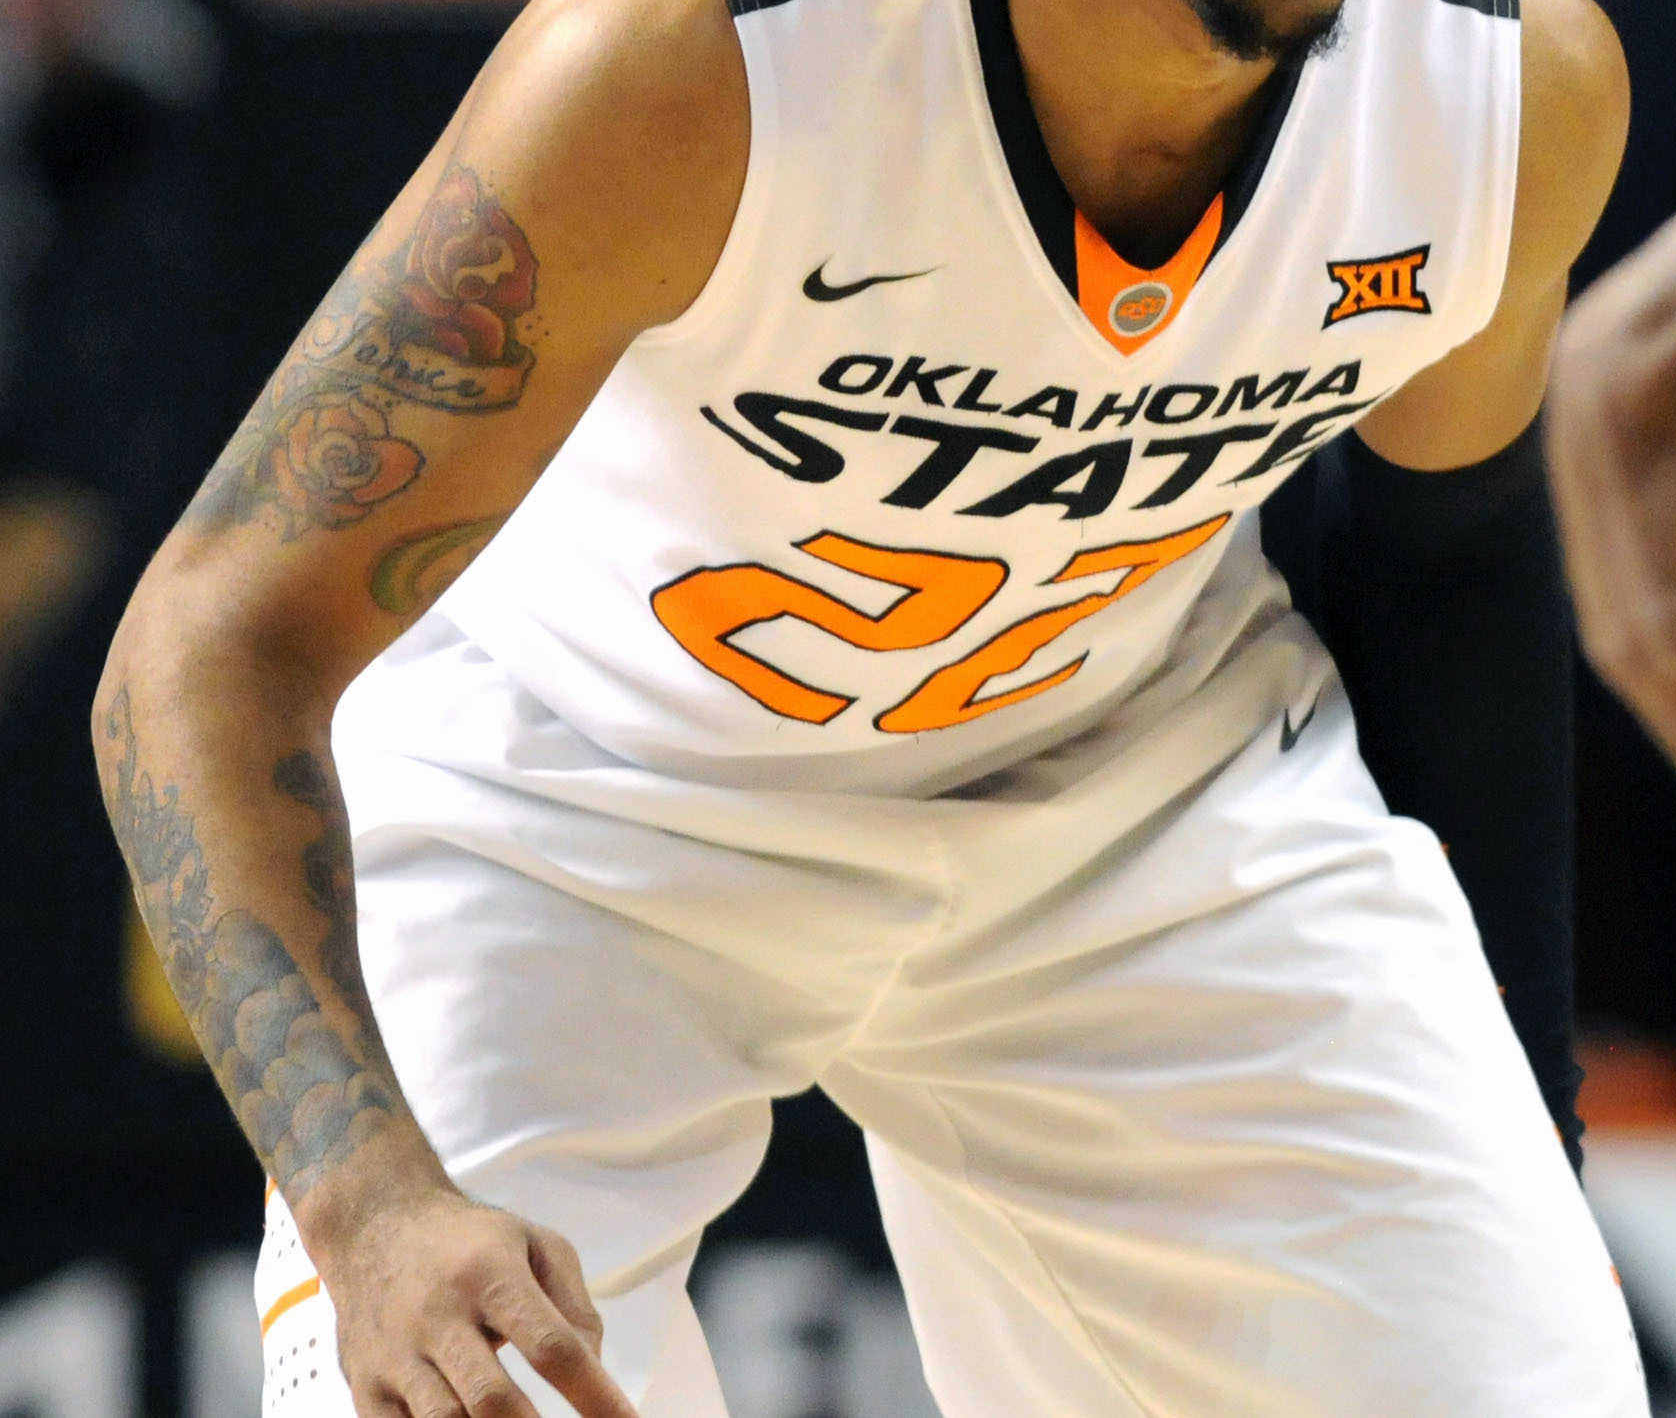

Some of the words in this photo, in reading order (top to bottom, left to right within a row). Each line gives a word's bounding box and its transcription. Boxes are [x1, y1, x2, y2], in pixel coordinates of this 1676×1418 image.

[1322, 243, 1431, 330] XII
[816, 355, 1362, 433] OKLAHOMA
[699, 384, 1396, 521] STATE
[650, 511, 1233, 734] 22
